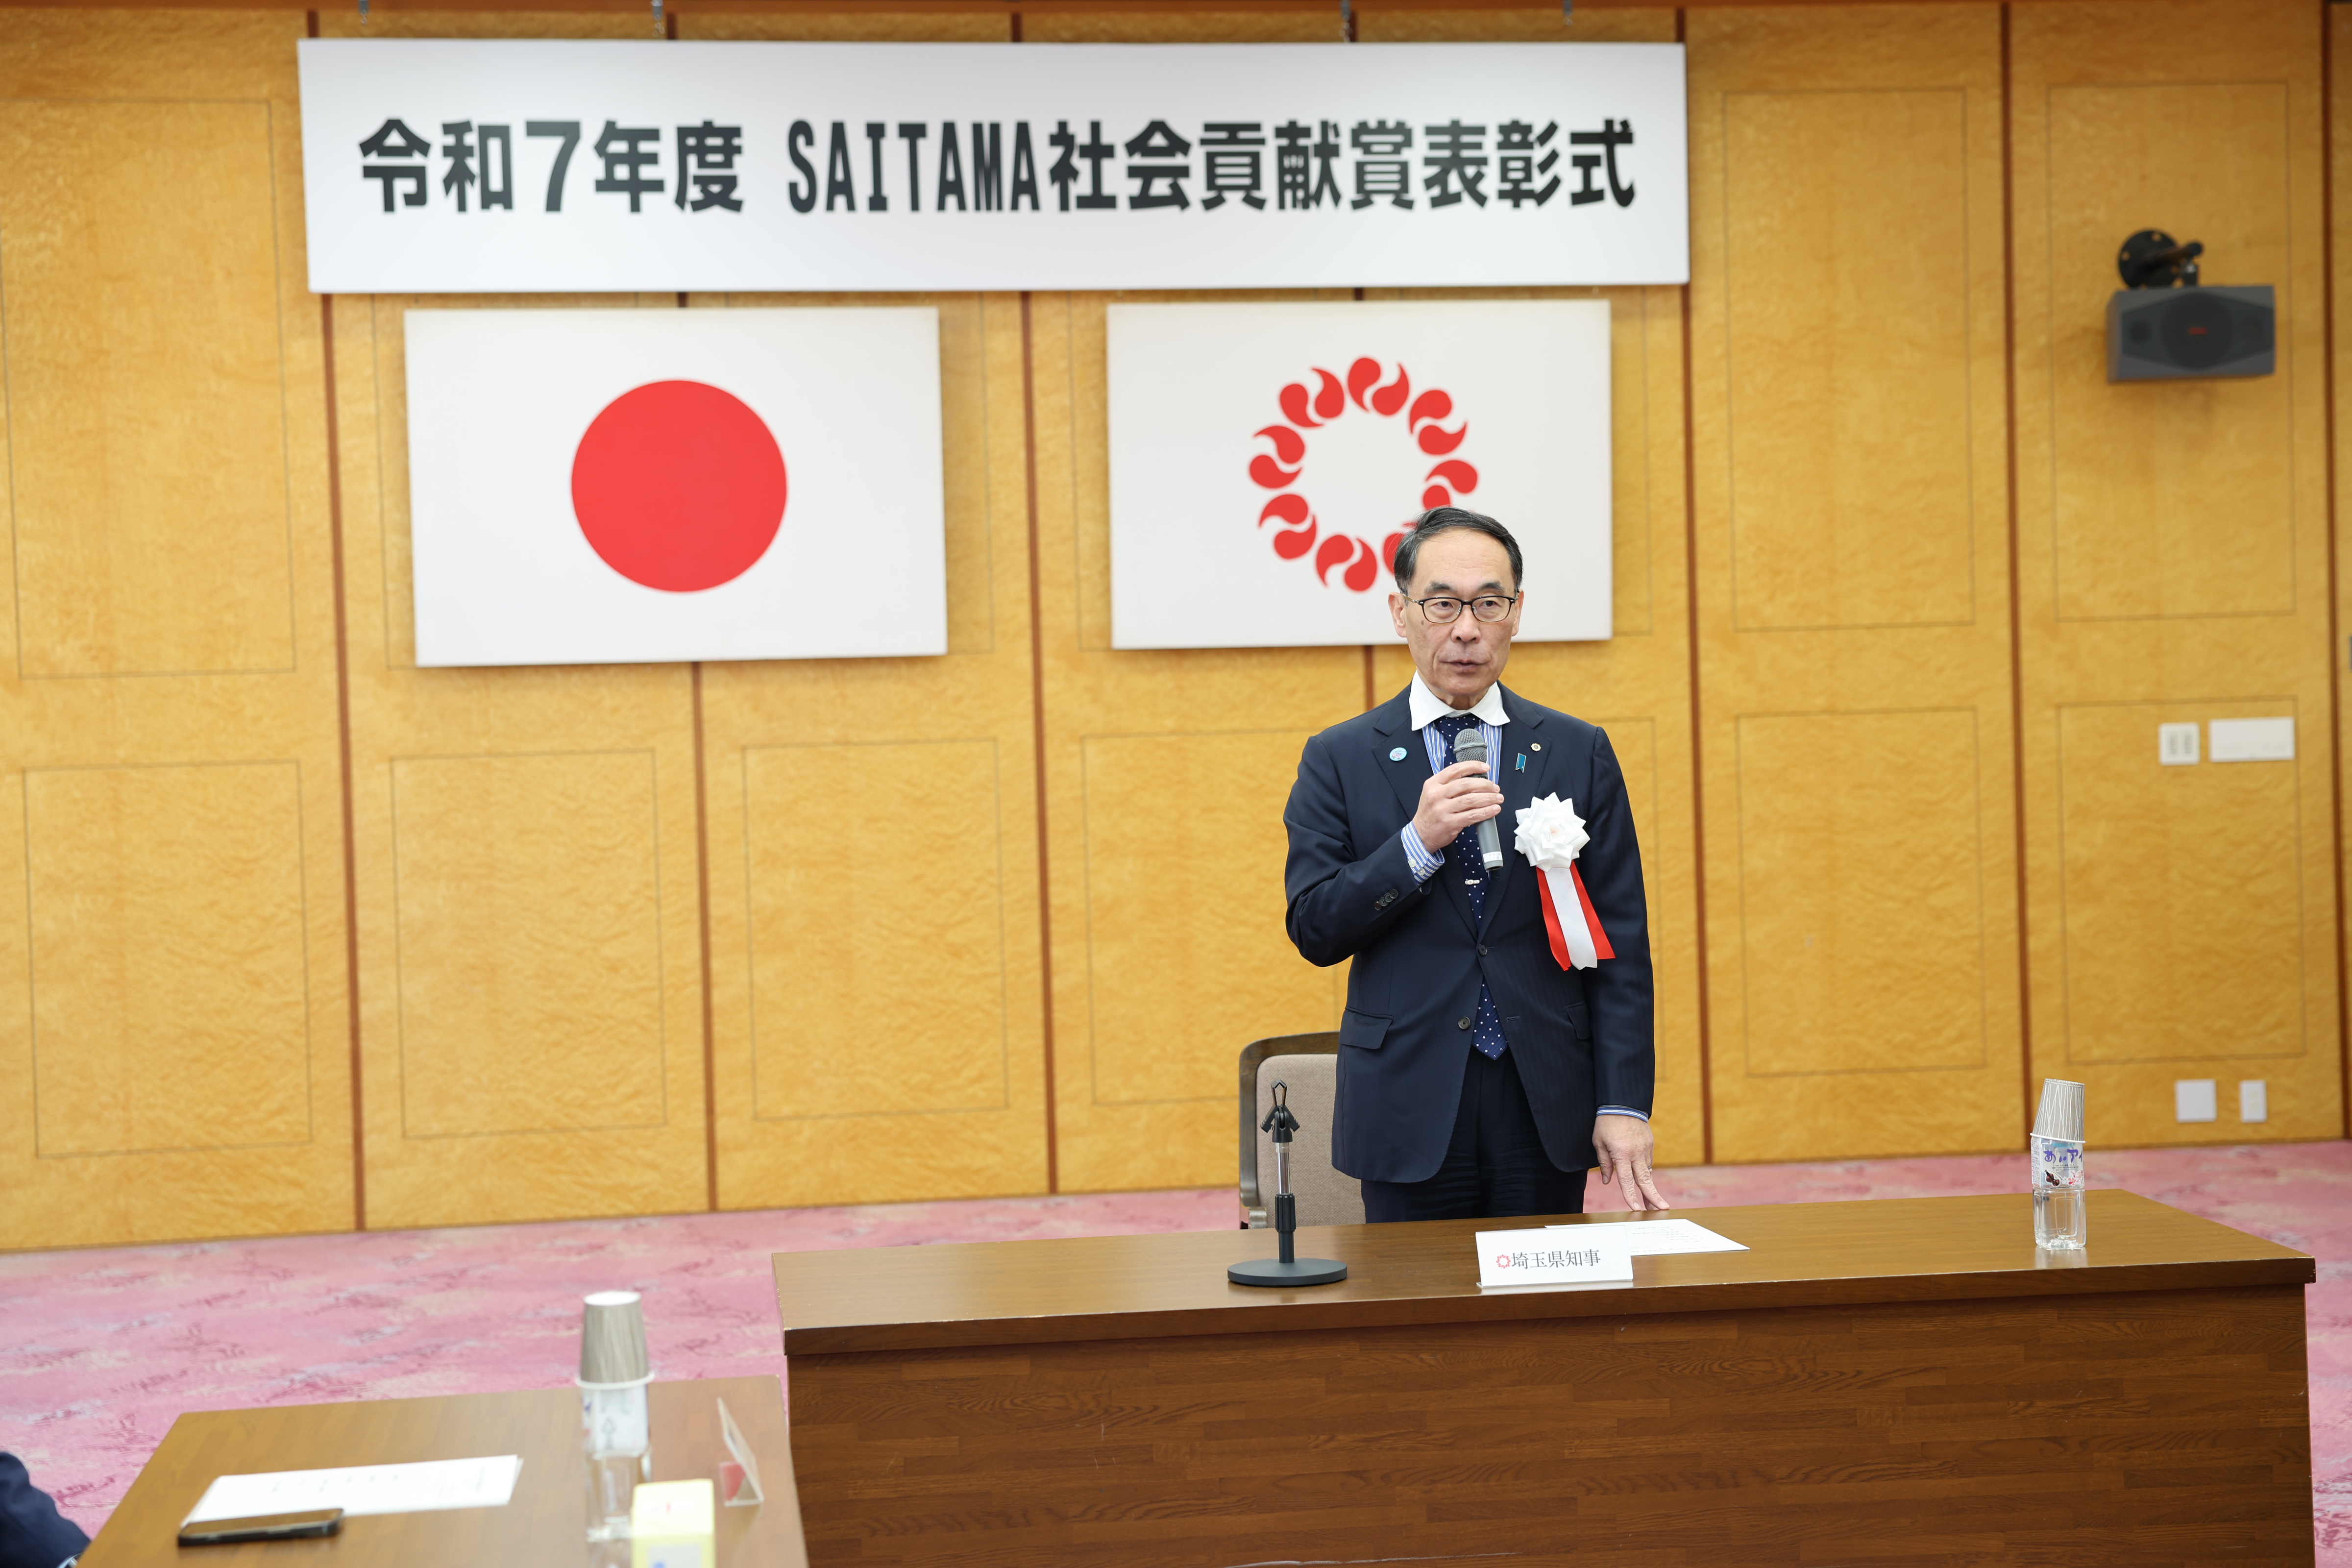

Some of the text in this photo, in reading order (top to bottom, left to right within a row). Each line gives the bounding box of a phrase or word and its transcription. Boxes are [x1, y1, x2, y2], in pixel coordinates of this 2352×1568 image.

[358, 118, 1636, 214] 令和7年度 SAITAMA社会貢献賞表彰式
[1511, 1249, 1601, 1270] 埼玉県知事
